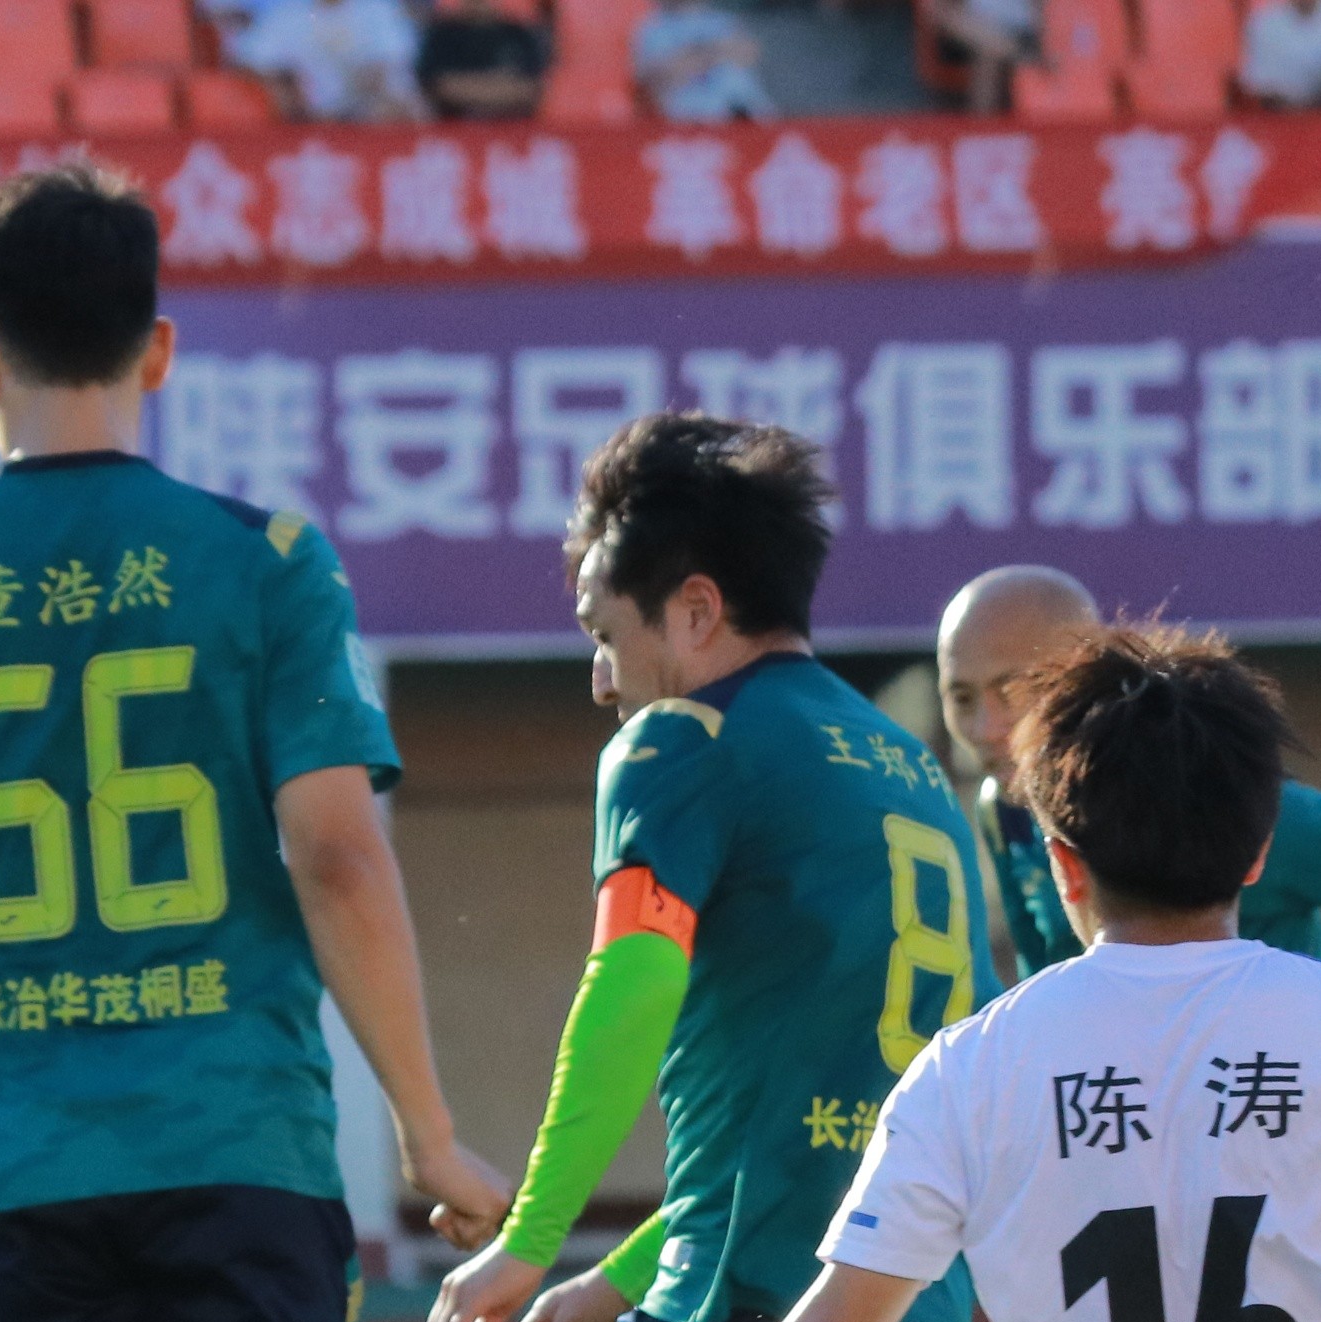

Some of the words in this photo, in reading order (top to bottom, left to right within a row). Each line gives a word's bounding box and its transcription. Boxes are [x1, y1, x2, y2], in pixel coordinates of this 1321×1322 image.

[160, 138, 586, 268] 众志成城
[644, 130, 1046, 260] 革命老区
[876, 813, 975, 1075] 8
